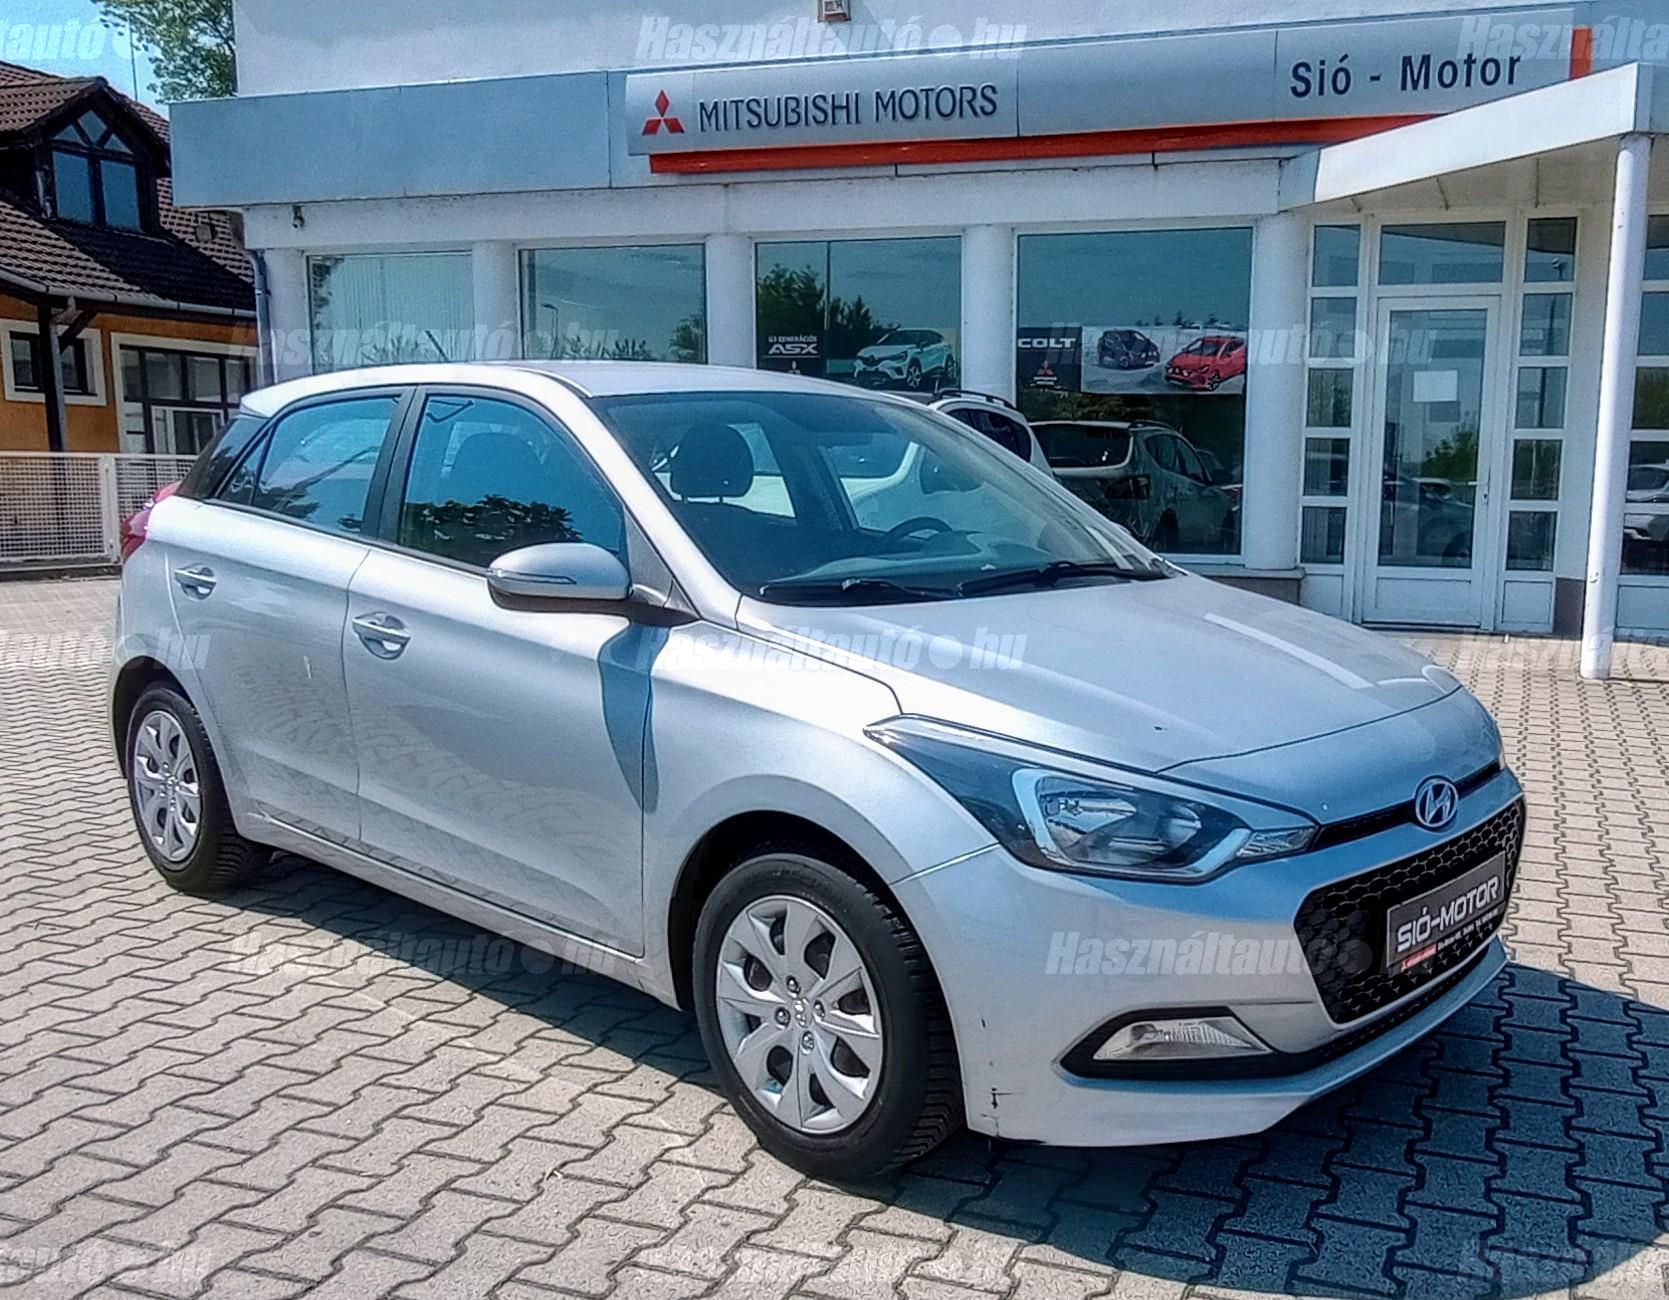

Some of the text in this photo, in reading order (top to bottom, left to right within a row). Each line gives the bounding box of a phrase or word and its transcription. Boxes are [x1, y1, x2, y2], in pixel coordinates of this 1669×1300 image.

[1290, 54, 1351, 98] Sió
[1401, 53, 1521, 91] Motor
[699, 84, 998, 132] MITSUBISHI MOTORS
[768, 343, 819, 355] ASX
[1017, 337, 1077, 348] COLT
[1397, 876, 1499, 953] SIÓ-MOTOR
